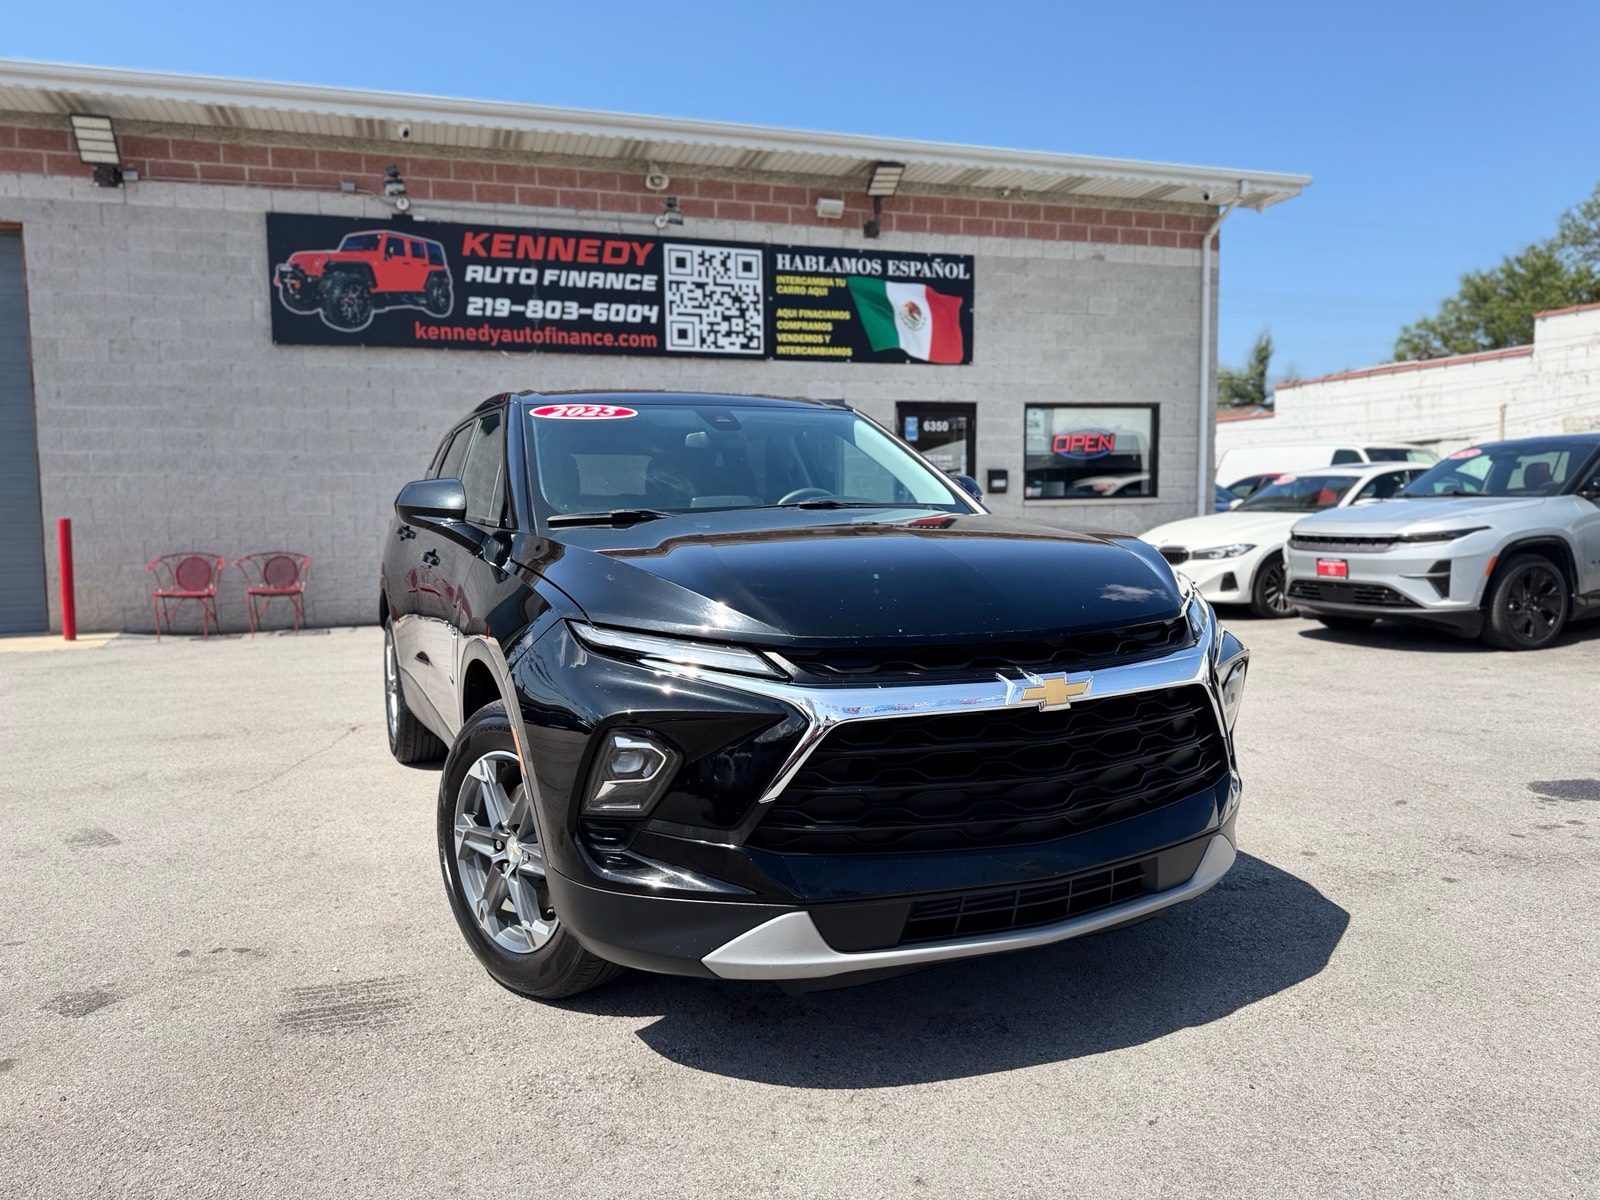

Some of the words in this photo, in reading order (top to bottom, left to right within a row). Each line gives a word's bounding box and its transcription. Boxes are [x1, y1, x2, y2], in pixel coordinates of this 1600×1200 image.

[462, 232, 654, 265] KENNEDY
[776, 254, 882, 275] HABLAMOS
[887, 258, 970, 279] ESPAÑOL
[465, 265, 538, 285] AUTO
[543, 269, 658, 291] FINANCE
[776, 275, 834, 286] INTERCAMBIA
[835, 278, 846, 287] TU
[776, 285, 806, 295] CARRO
[807, 287, 828, 297] AQUI
[466, 296, 659, 323] 219-803-6004
[776, 308, 797, 319] AQUI
[776, 320, 833, 331] COMPRAMOS
[415, 321, 658, 347] kennedyautofinance.com
[776, 333, 823, 343] VENDEMOS
[824, 335, 831, 343] Y
[776, 345, 853, 356] INTERCAMBIAMOS
[923, 421, 949, 432] 6350
[1052, 433, 1115, 453] OPEN
